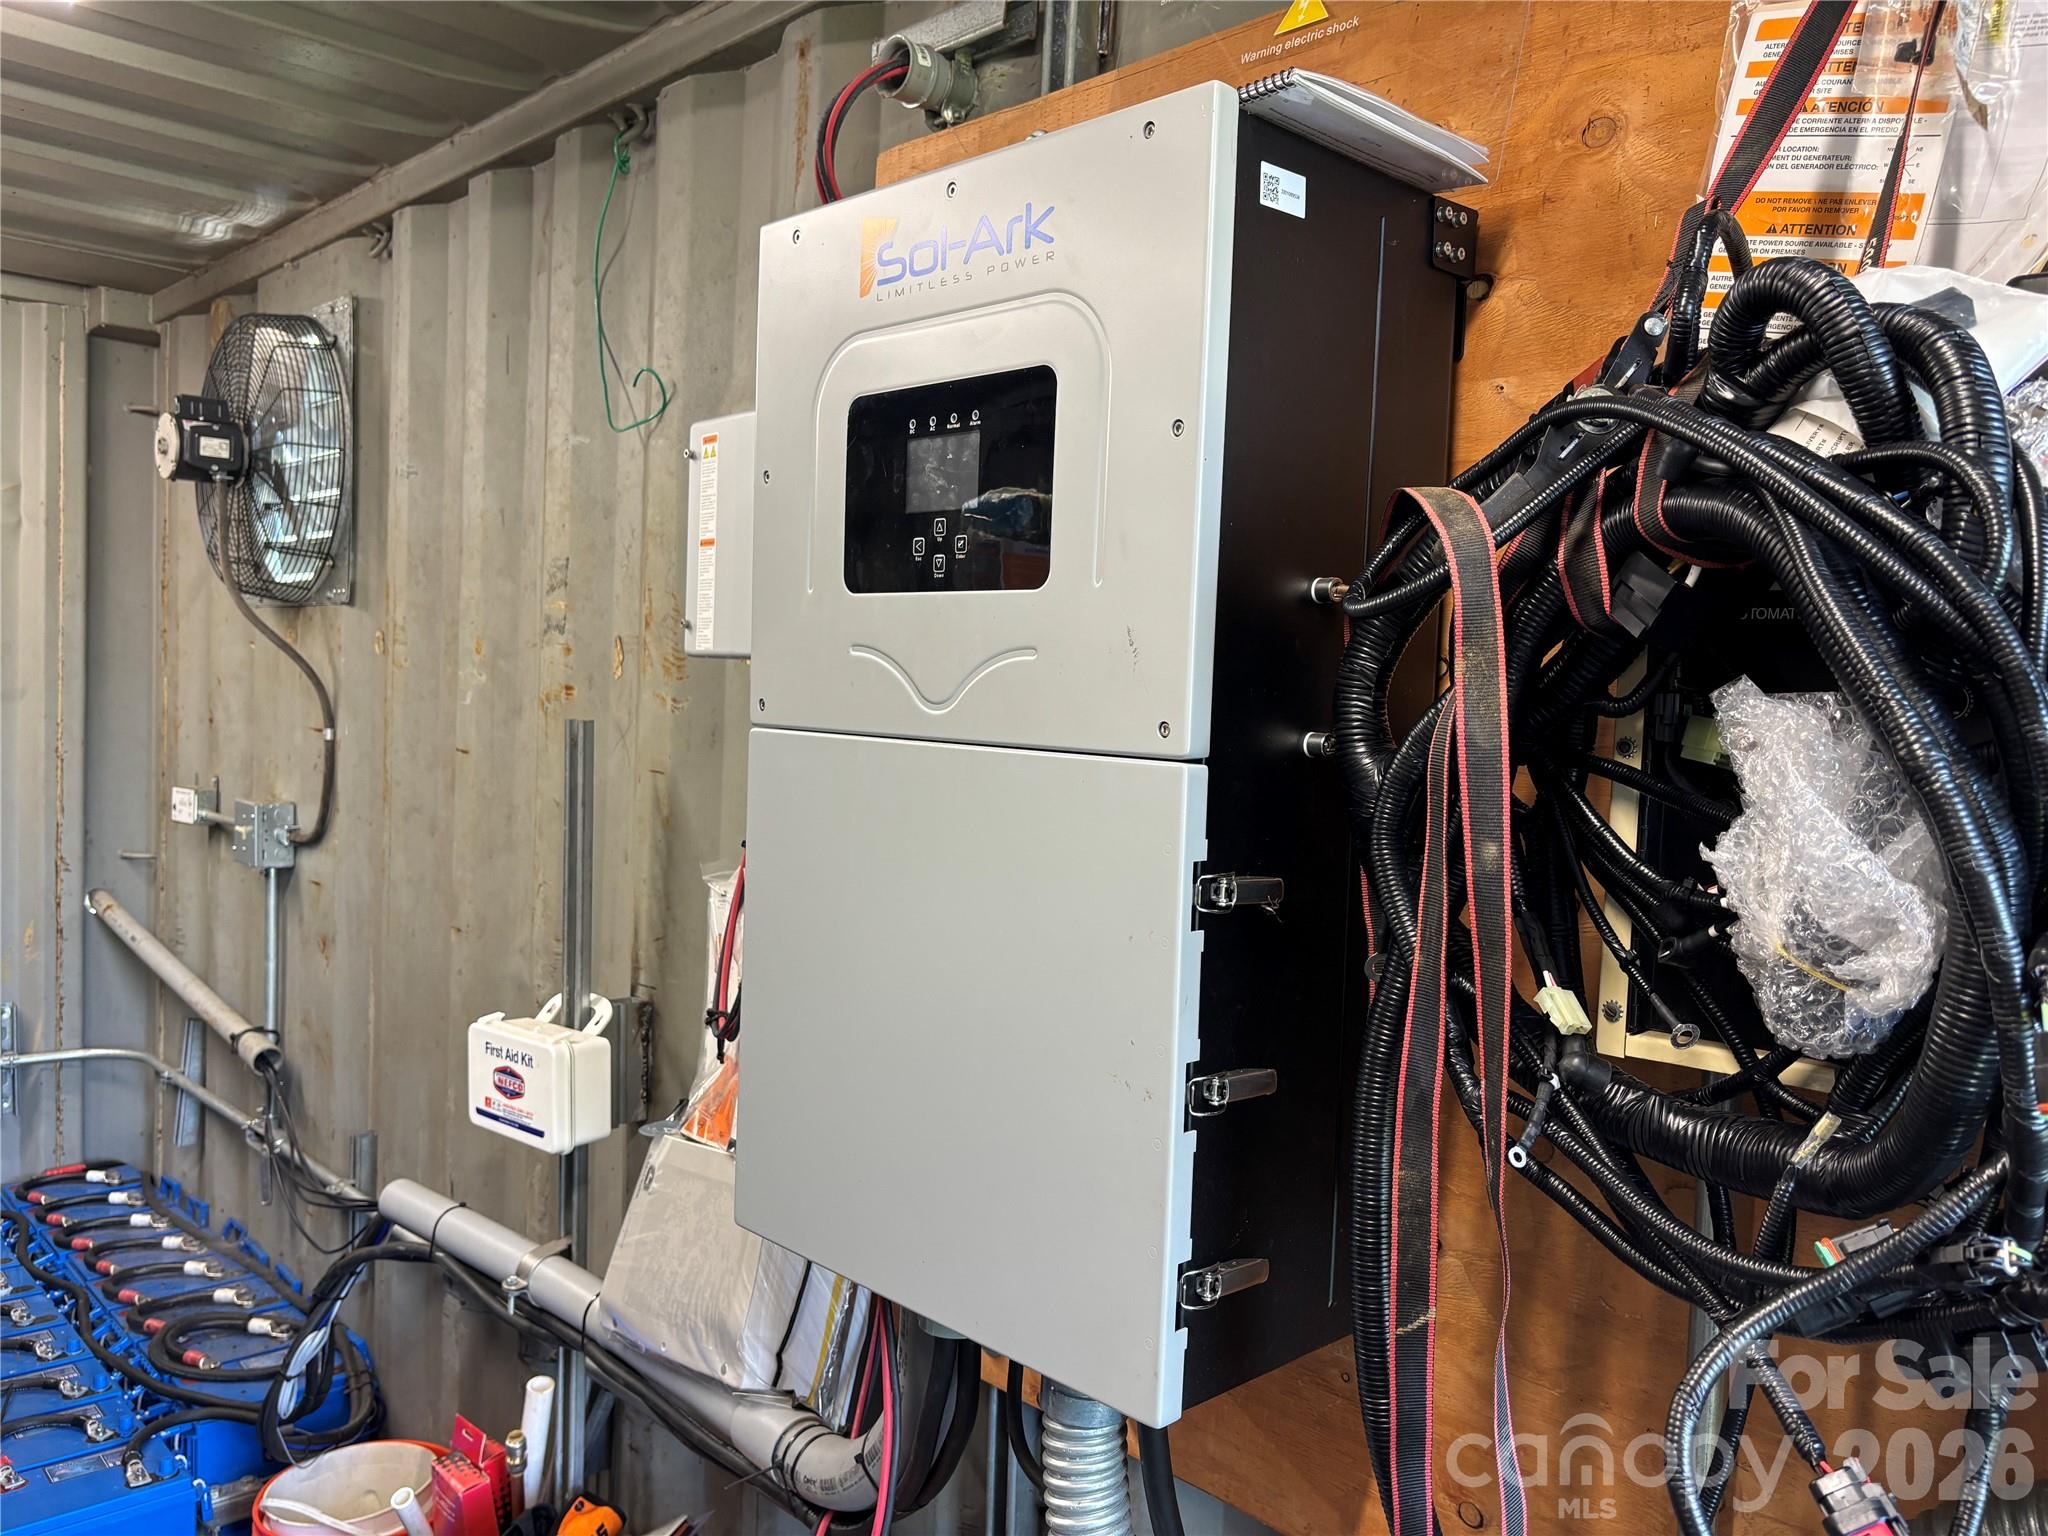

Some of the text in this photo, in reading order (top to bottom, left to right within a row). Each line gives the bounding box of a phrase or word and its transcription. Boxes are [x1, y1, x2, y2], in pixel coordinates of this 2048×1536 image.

[1241, 16, 1359, 64] Warning electric shock
[1764, 42, 1787, 50] ALTER
[1811, 98, 1884, 113] ATENCIÓN
[1780, 224, 1857, 236] ATTENTION
[877, 202, 1055, 286] Sol-Ark
[876, 251, 1055, 302] LIMITLESS POWER
[485, 1041, 533, 1068] First Aid Kit
